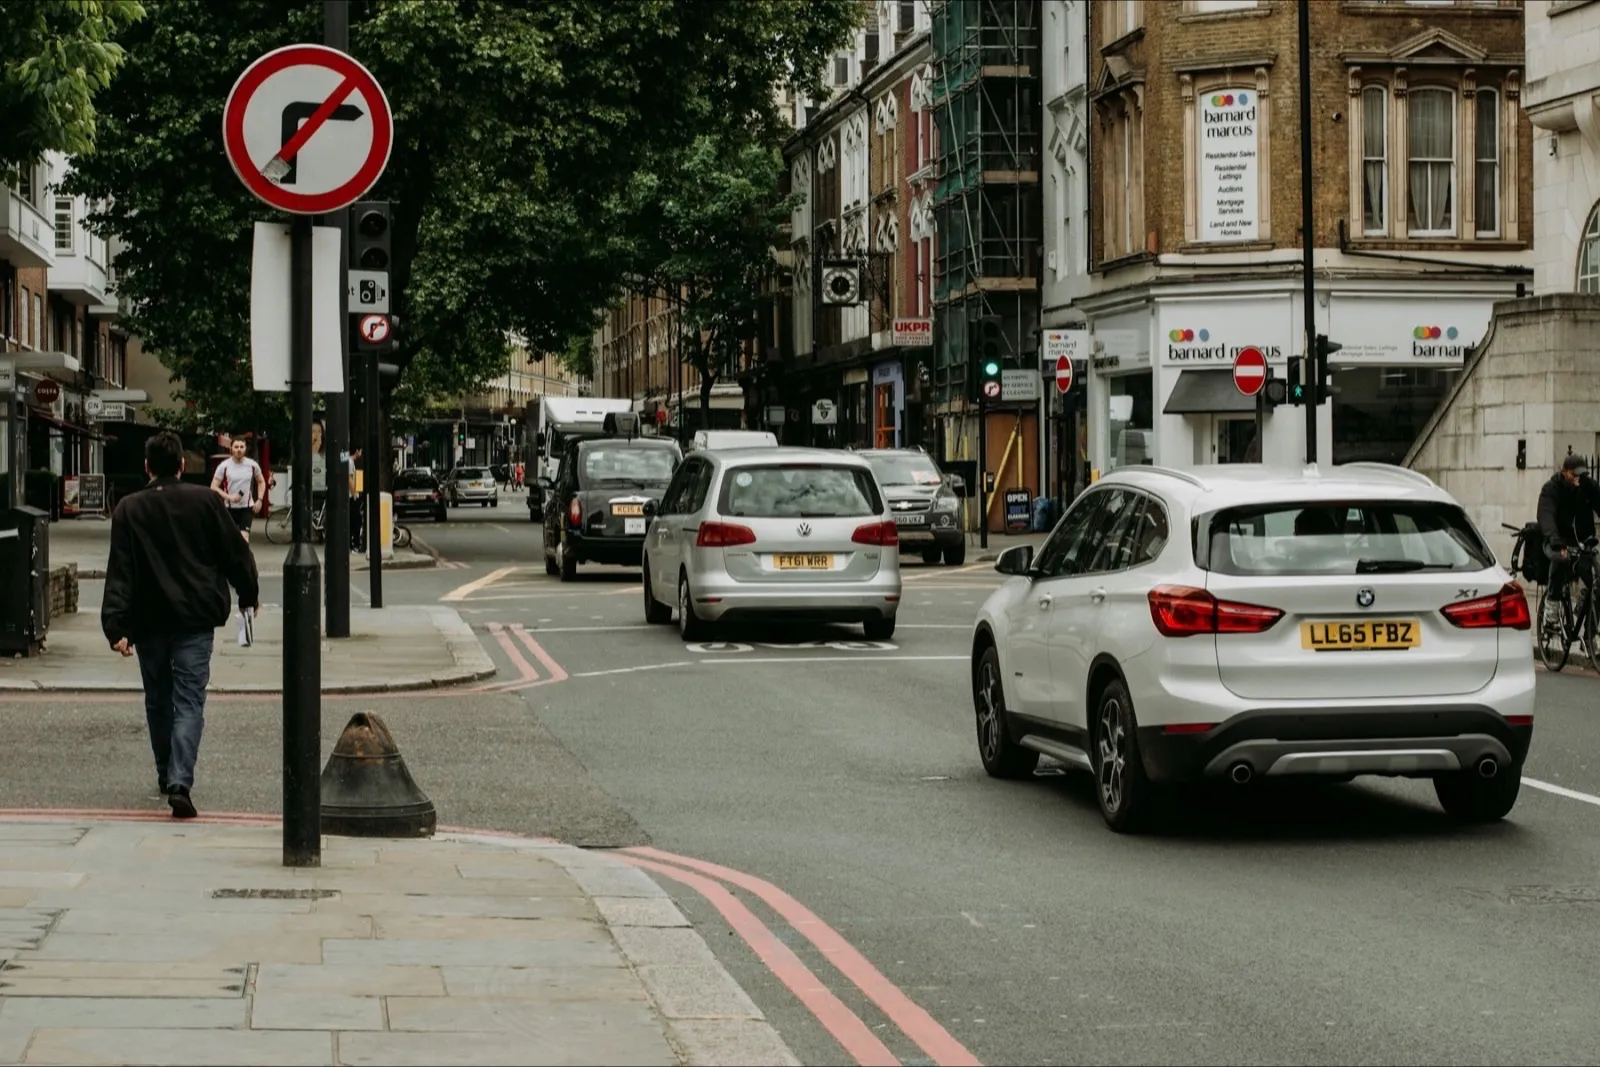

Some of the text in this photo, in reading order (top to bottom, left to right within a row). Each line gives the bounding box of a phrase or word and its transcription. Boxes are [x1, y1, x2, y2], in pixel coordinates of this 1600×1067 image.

[1204, 106, 1255, 123] barnard
[1207, 125, 1253, 138] marcus
[1205, 151, 1238, 159] Residential
[1214, 163, 1247, 172] Residential
[1218, 173, 1242, 181] Lettings
[1217, 185, 1243, 193] Auctions
[1216, 199, 1245, 207] Mortgage
[895, 322, 930, 332] UKPR
[1048, 341, 1077, 349] barnard
[1168, 343, 1225, 360] barnard
[1007, 494, 1028, 503] OPEN
[780, 554, 828, 566] FT61 WRR
[1454, 588, 1478, 598] X1
[1310, 622, 1413, 644] LL65 FBZ
